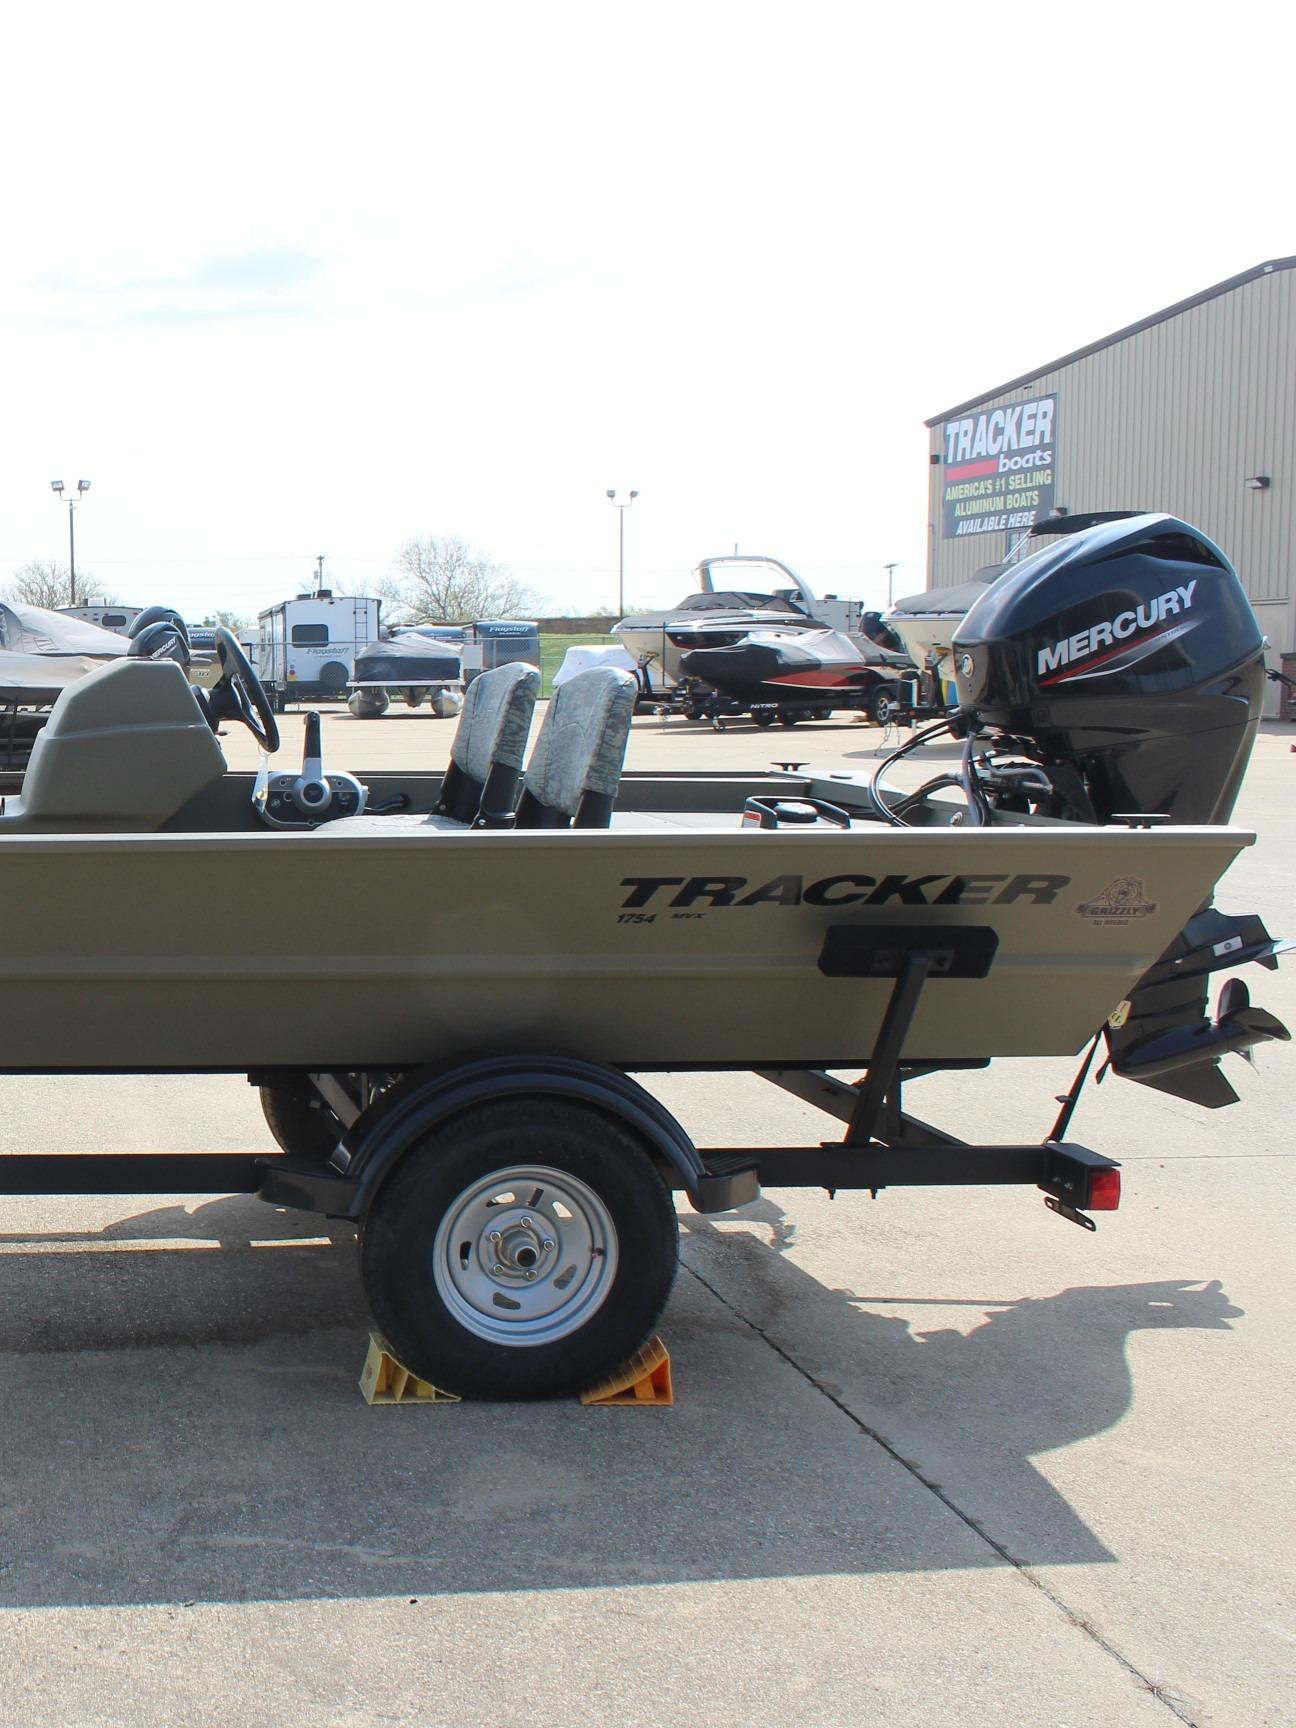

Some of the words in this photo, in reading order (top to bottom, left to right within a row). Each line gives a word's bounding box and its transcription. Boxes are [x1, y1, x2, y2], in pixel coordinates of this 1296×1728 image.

[945, 399, 1054, 464] TRACKER
[998, 450, 1052, 473] boats
[945, 480, 993, 502] AMERICA'S
[995, 477, 1005, 492] #1
[1008, 469, 1052, 491] SELLING
[954, 496, 1005, 517] ALUMINUM
[1006, 490, 1039, 508] BOATS
[955, 514, 1006, 536] AVAILABLE
[1007, 510, 1037, 529] HERE
[1037, 579, 1198, 676] MERCURY
[619, 874, 1072, 908] TRACKER
[616, 913, 657, 924] 1754
